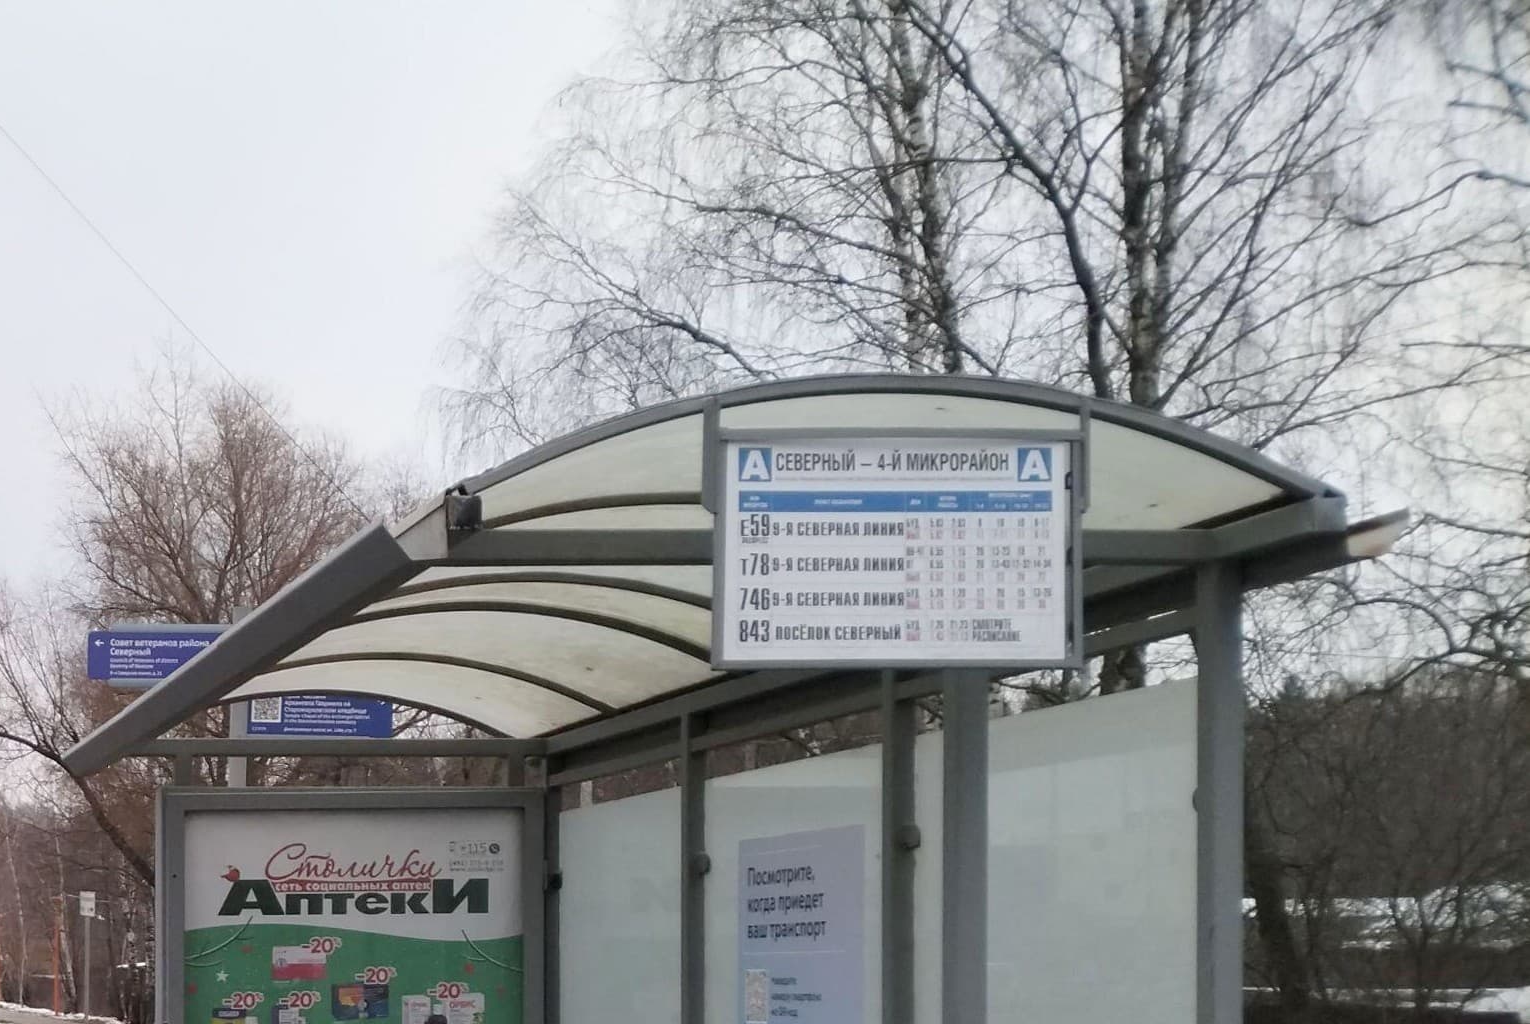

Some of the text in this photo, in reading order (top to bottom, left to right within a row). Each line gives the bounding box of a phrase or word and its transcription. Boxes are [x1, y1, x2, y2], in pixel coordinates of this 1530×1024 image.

[776, 449, 855, 471] СЕВЕРНЫЙ
[877, 449, 902, 471] 4-Й
[906, 449, 1009, 471] МИКРОРАЙОН
[772, 522, 794, 536] 9-Я
[797, 522, 860, 536] СЕВЕРНАЯ
[863, 522, 904, 536] ЛИНИЯ
[772, 557, 904, 571] 9-Я СЕВЕРНАЯ ЛИНИЯ
[739, 588, 770, 610] 746
[772, 592, 794, 606] 9-Я
[797, 592, 860, 606] СЕВЕРНАЯ
[863, 592, 904, 606] ЛИНИЯ
[739, 619, 770, 642] 843
[775, 624, 831, 640] ПОСЁЛОК
[835, 624, 901, 640] СЕВЕРНЫЙ
[110, 638, 210, 648] Совет ветеранов района
[110, 647, 152, 656] Северный
[264, 843, 442, 881] Столички
[747, 865, 815, 887] Посмотрите,
[275, 881, 431, 893] сеть социальных аптек
[747, 891, 824, 915] когда приедет
[747, 920, 827, 943] ваш транспорт
